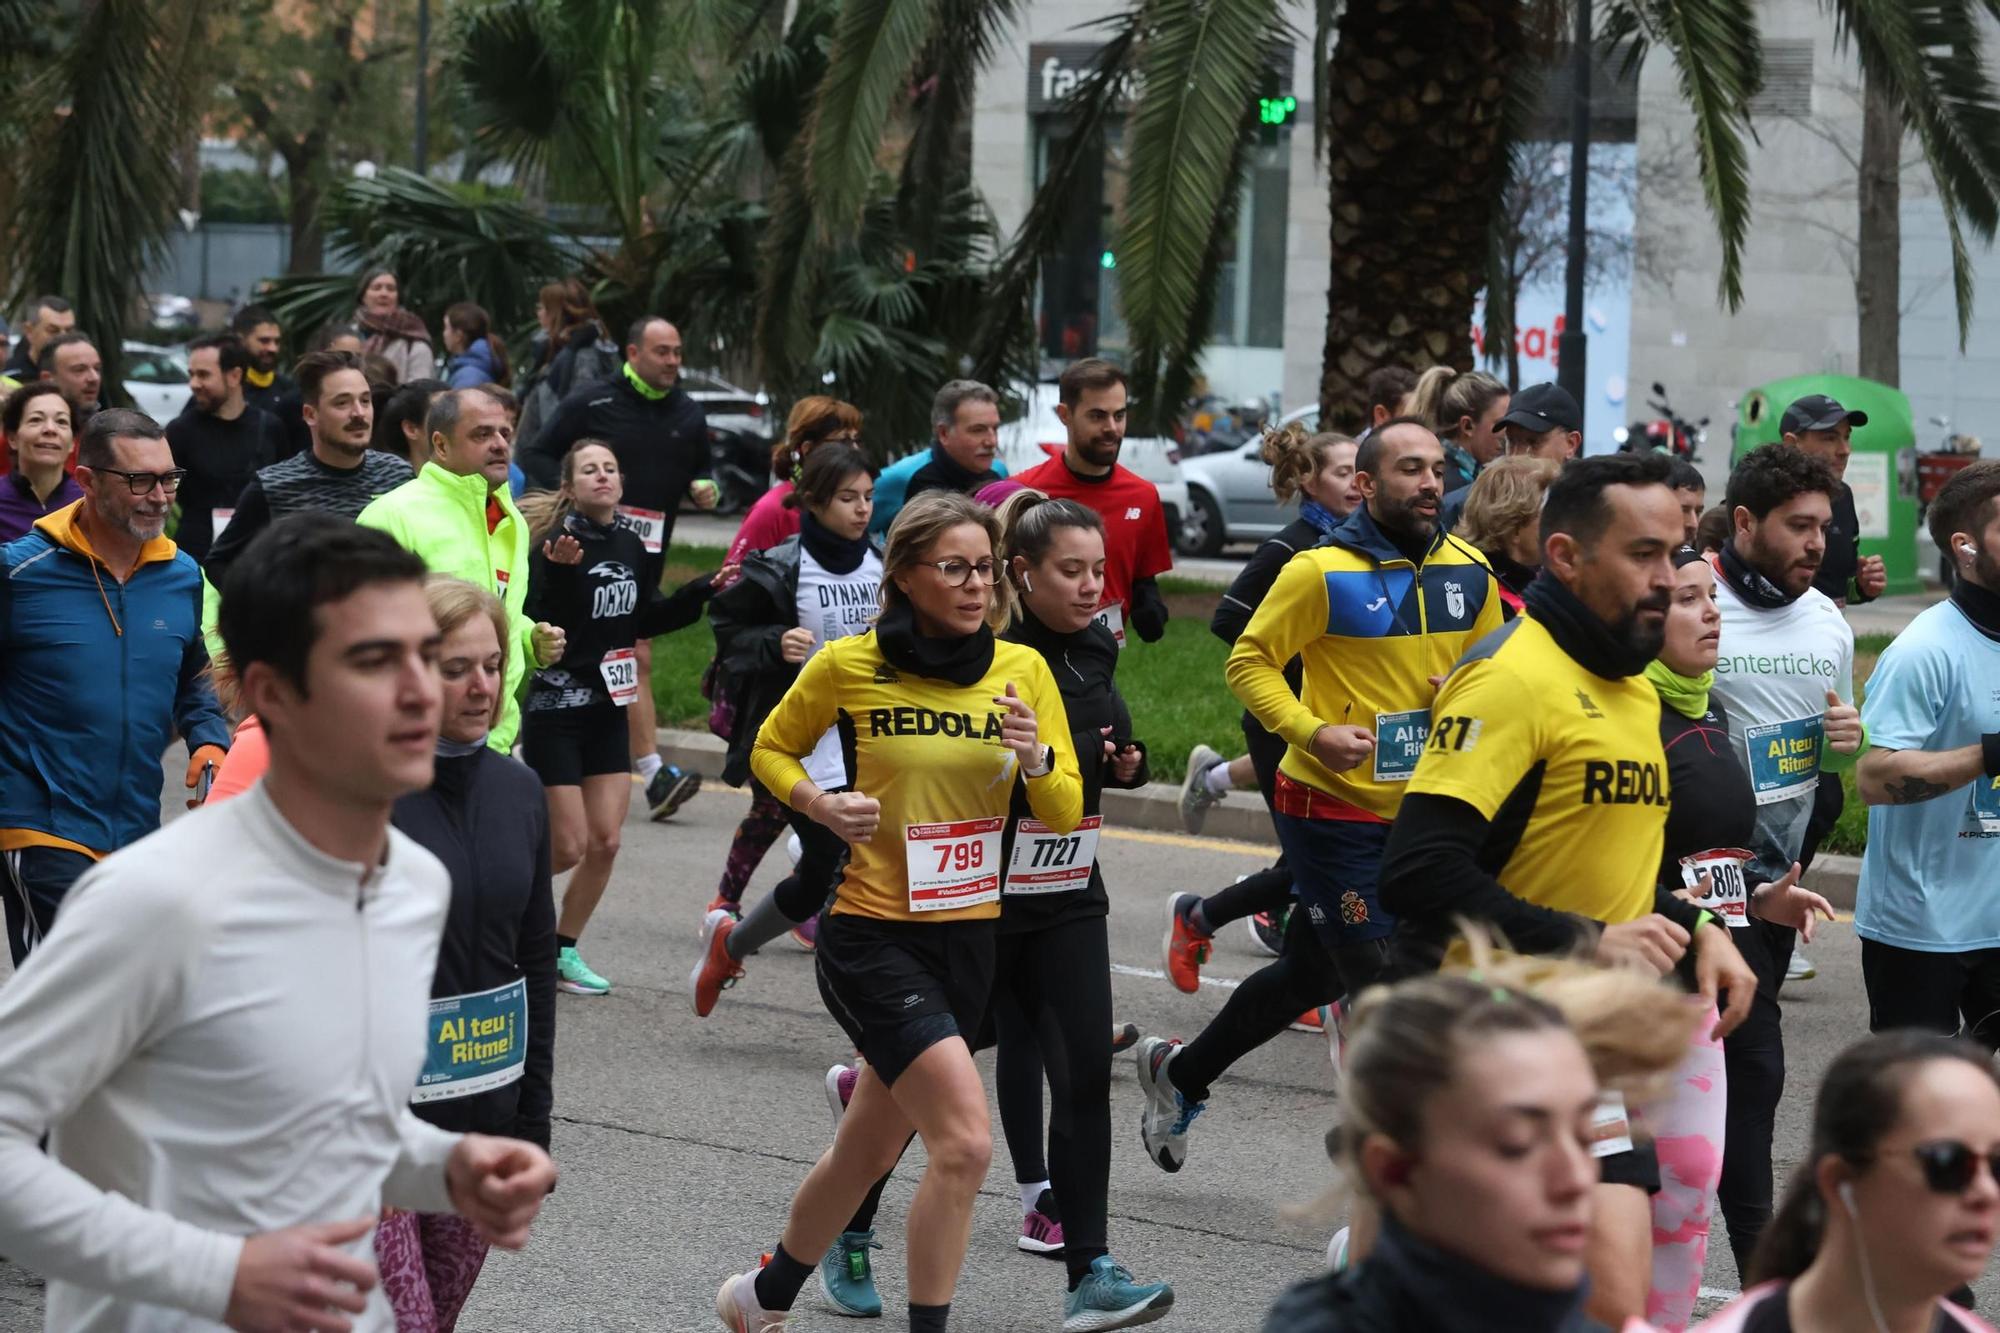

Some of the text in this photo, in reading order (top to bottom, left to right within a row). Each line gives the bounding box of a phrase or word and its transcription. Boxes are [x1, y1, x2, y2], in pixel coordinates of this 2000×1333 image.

[1715, 653, 1837, 678] enterticke
[870, 706, 1004, 740] REDOLA
[1394, 725, 1414, 743] Al
[1767, 738, 1787, 758] Al
[1789, 737, 1813, 754] teu
[1778, 755, 1815, 775] Ritme
[1582, 760, 1668, 806] REDOL
[933, 840, 983, 872] 799
[1030, 836, 1081, 868] 7727
[438, 1017, 466, 1044] Al
[470, 1015, 506, 1038] teu
[452, 1037, 509, 1065] Ritme
